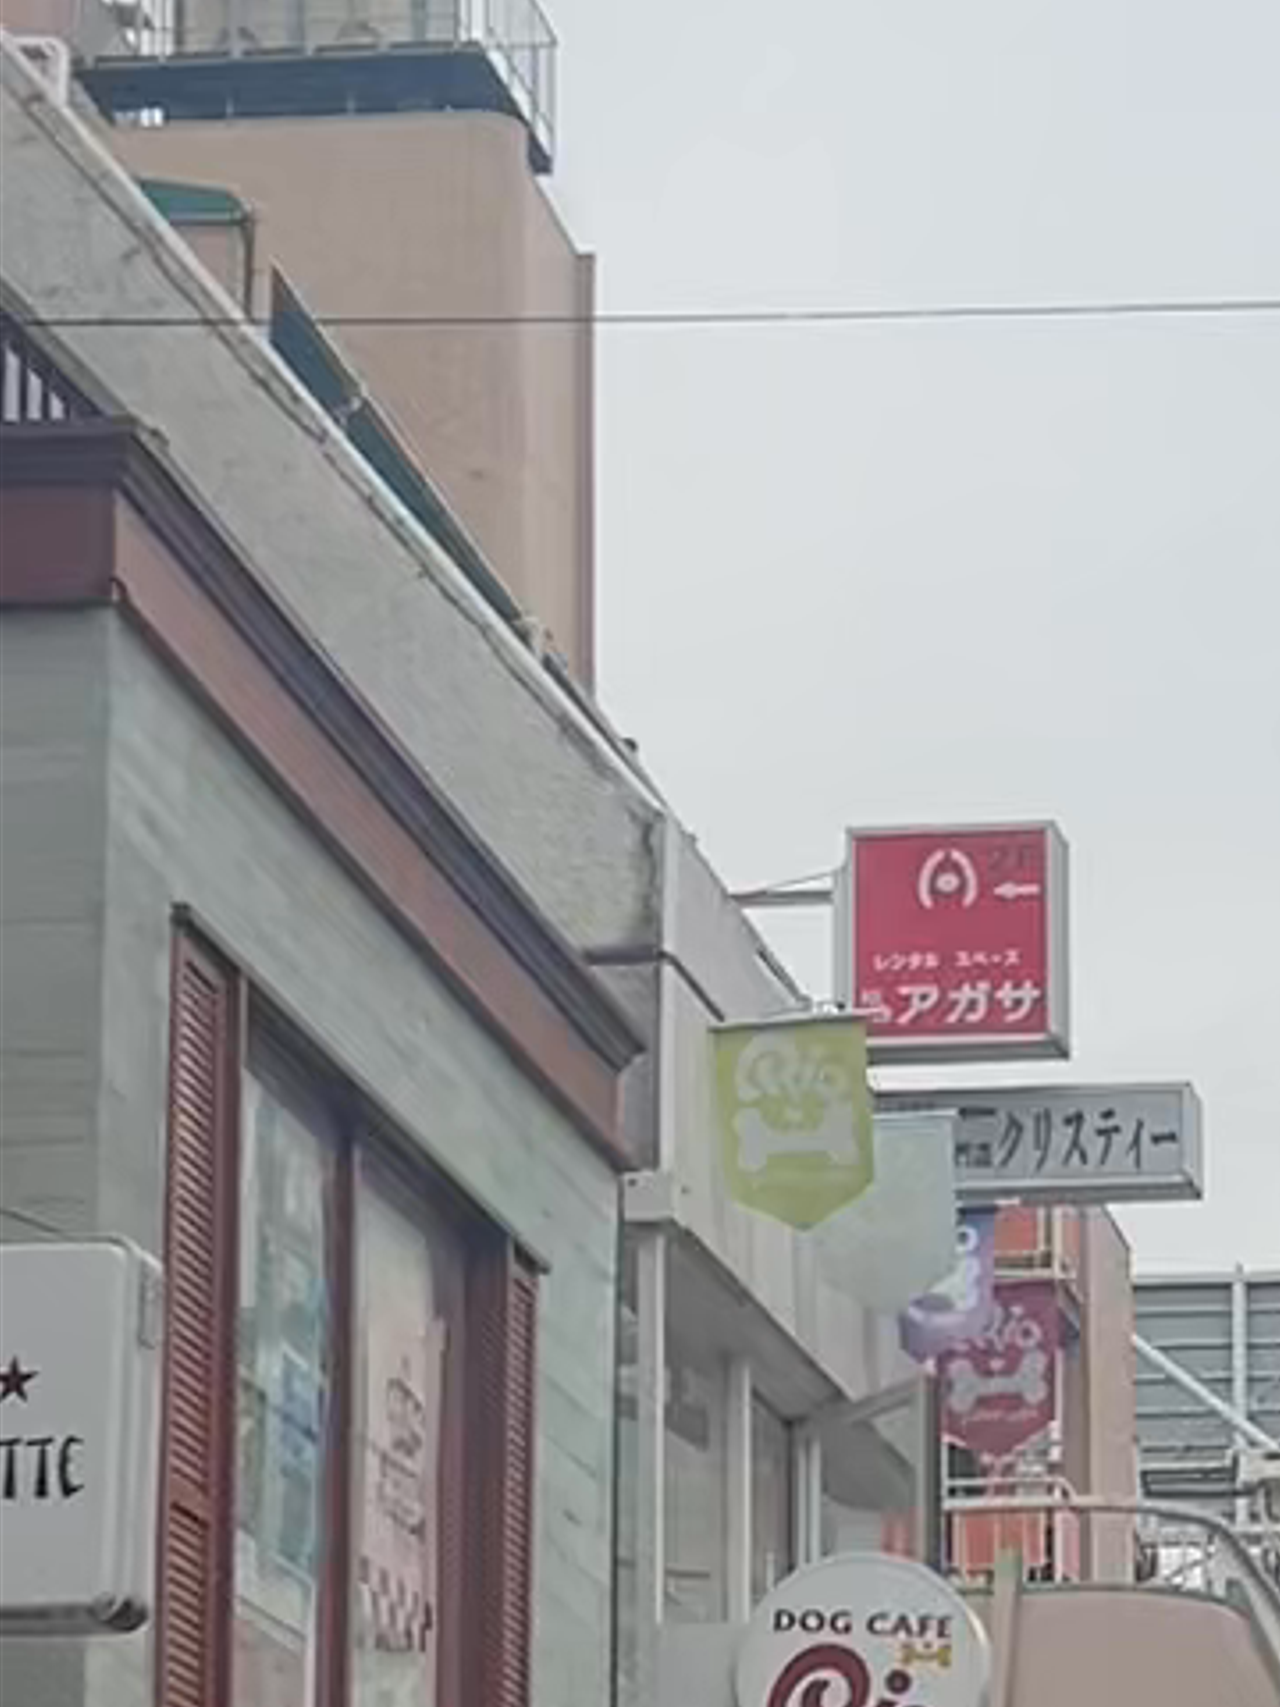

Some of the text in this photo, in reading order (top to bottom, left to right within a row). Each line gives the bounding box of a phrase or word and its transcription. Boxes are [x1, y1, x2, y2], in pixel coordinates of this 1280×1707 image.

[997, 1107, 1178, 1173] クリスティー
[772, 1609, 953, 1640] DOG CAFE
